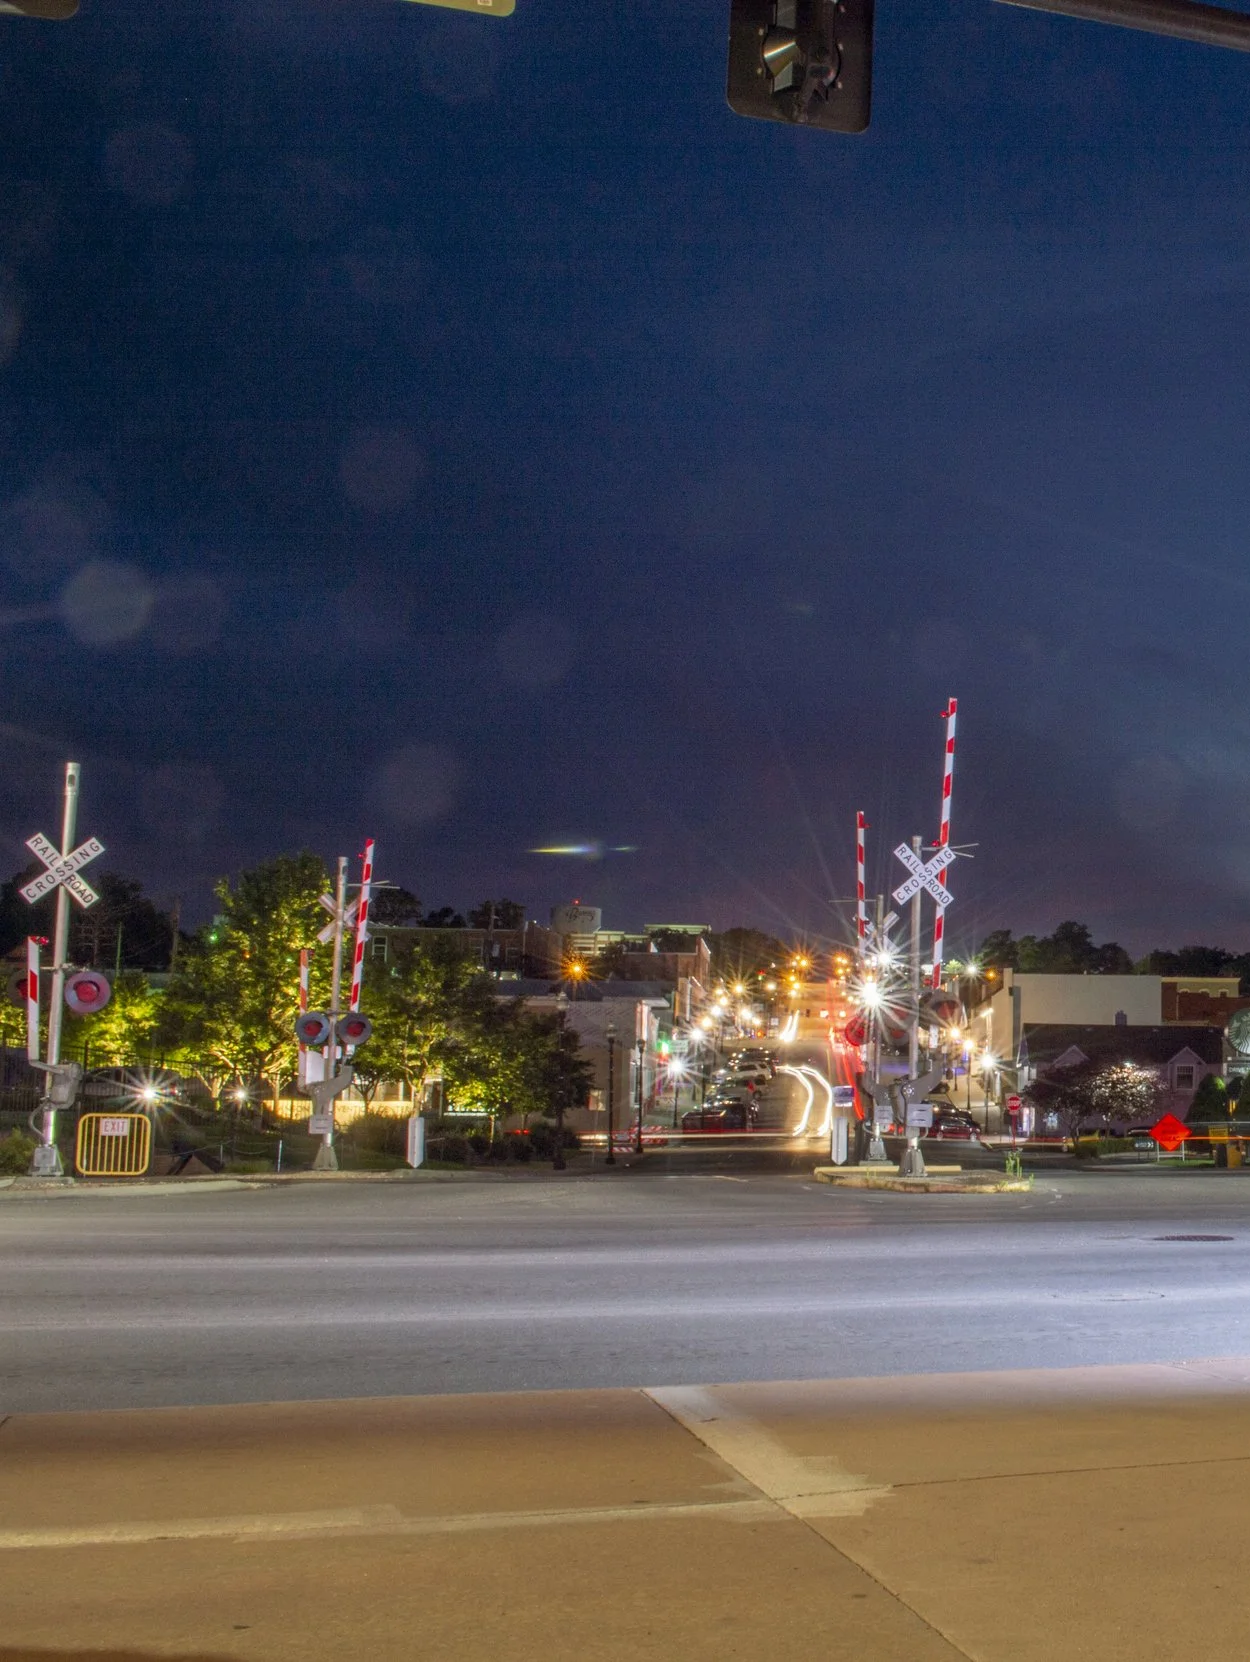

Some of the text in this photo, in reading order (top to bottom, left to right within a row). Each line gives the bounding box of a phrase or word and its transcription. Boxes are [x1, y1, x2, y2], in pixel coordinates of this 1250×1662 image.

[25, 841, 100, 899] CROSSING
[896, 850, 953, 901] CROSSING
[104, 1120, 126, 1133] EXIT
